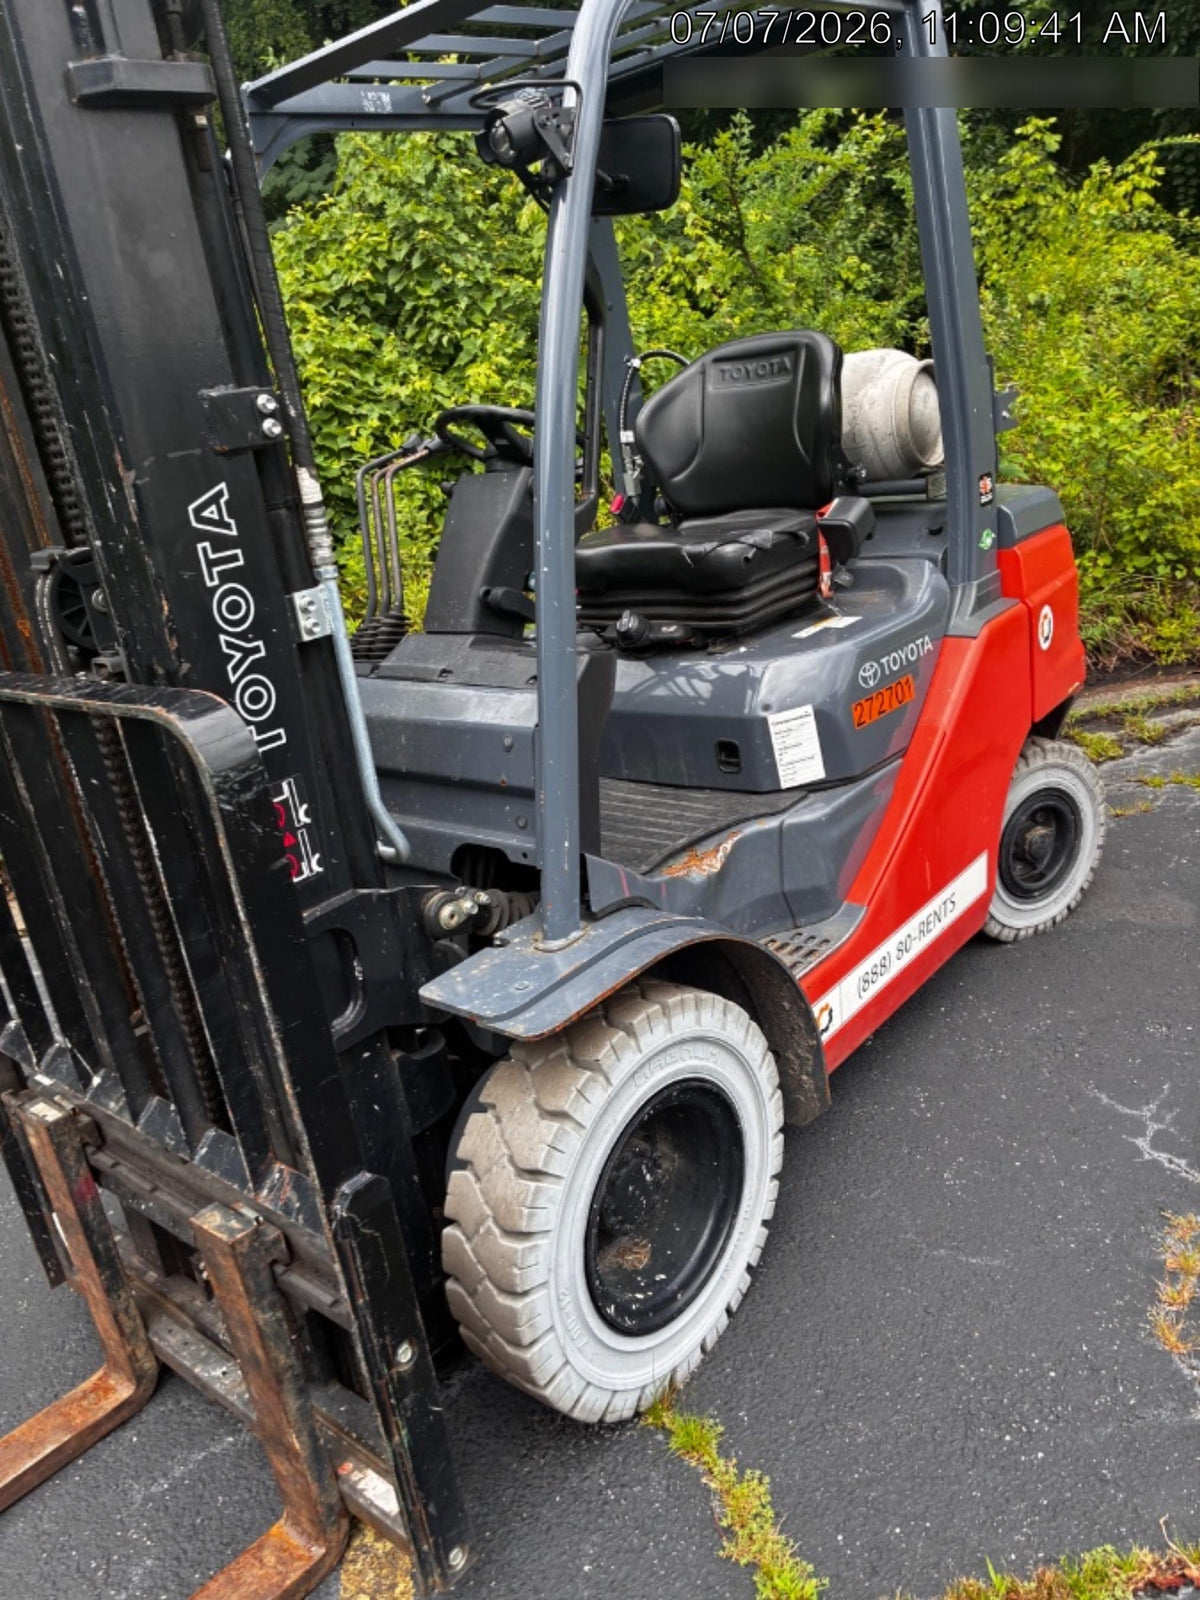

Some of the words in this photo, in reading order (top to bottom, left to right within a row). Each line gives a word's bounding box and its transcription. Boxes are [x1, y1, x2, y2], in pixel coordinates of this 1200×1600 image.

[719, 356, 791, 382] TOYOTA
[880, 635, 933, 675] TOYOTA
[854, 677, 912, 728] 272701
[857, 951, 891, 999] (888)
[896, 892, 955, 961] 80-RENTS
